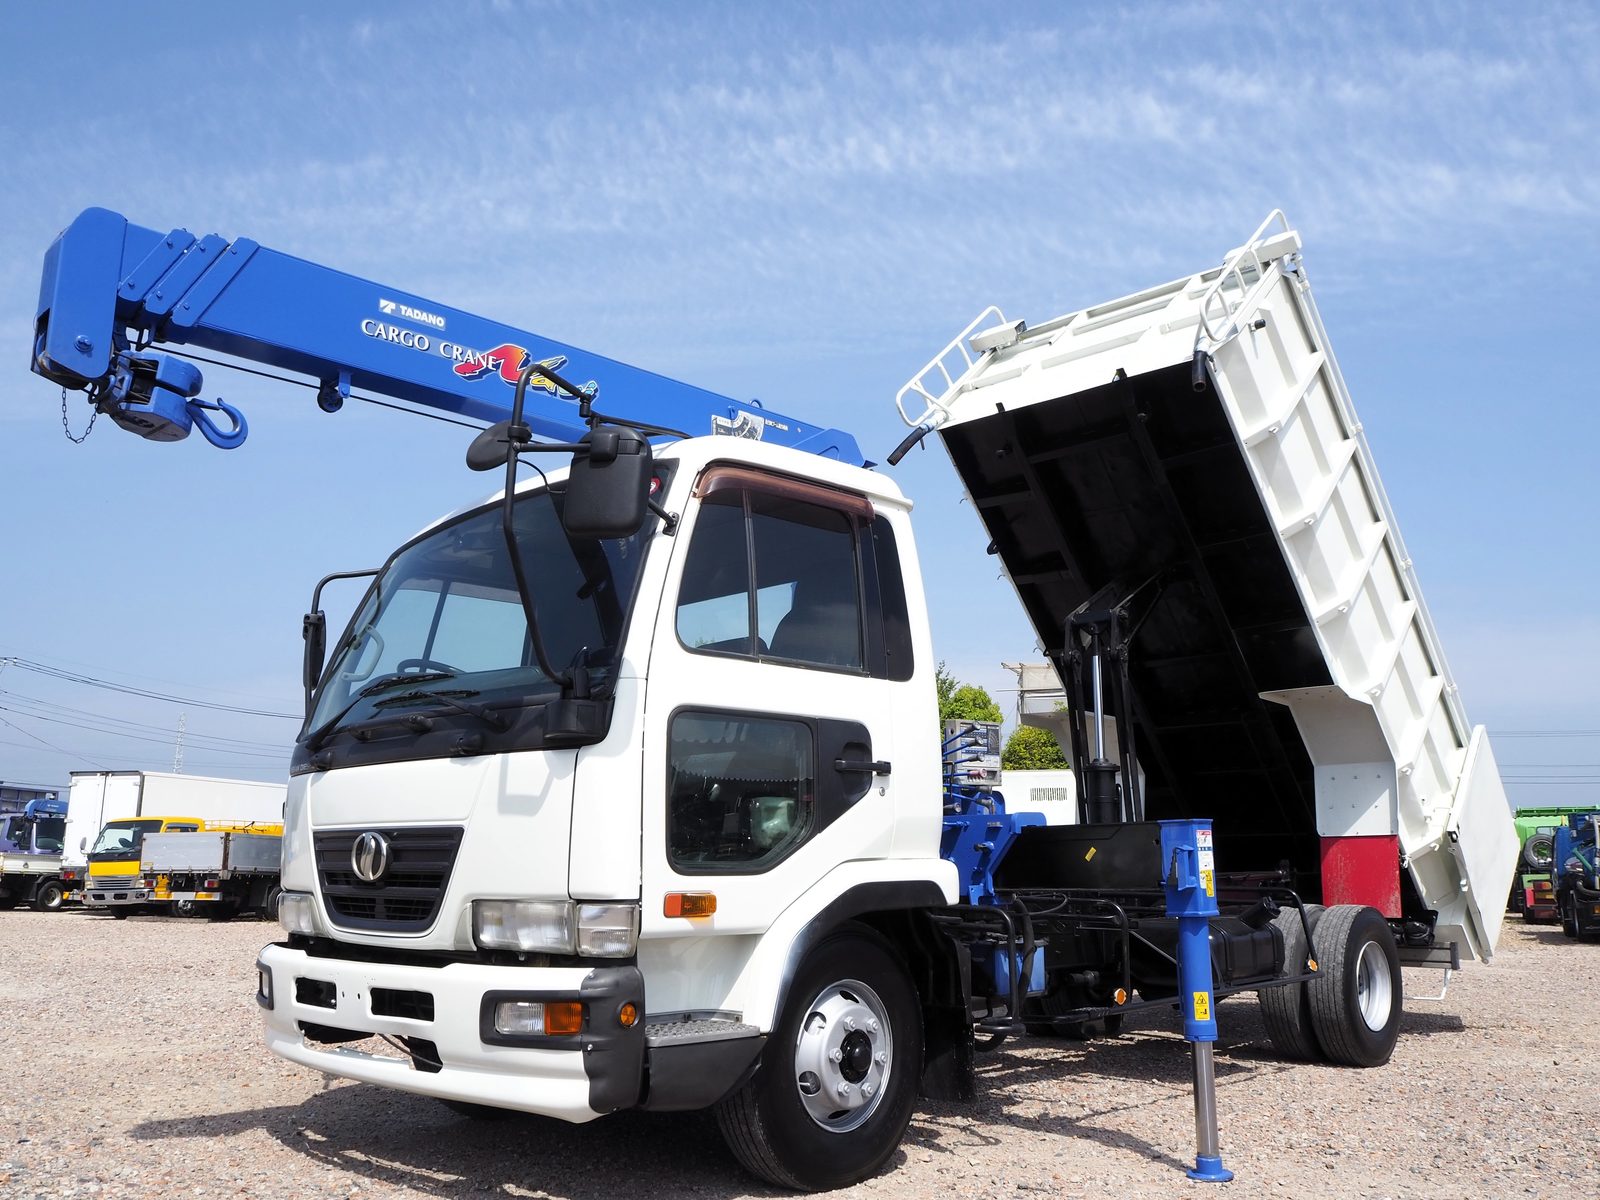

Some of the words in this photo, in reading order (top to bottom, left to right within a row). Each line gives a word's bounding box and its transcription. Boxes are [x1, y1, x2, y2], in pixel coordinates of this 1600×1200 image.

[399, 305, 445, 327] TADANO
[361, 319, 430, 351] CARGO
[439, 342, 497, 371] CRANE
